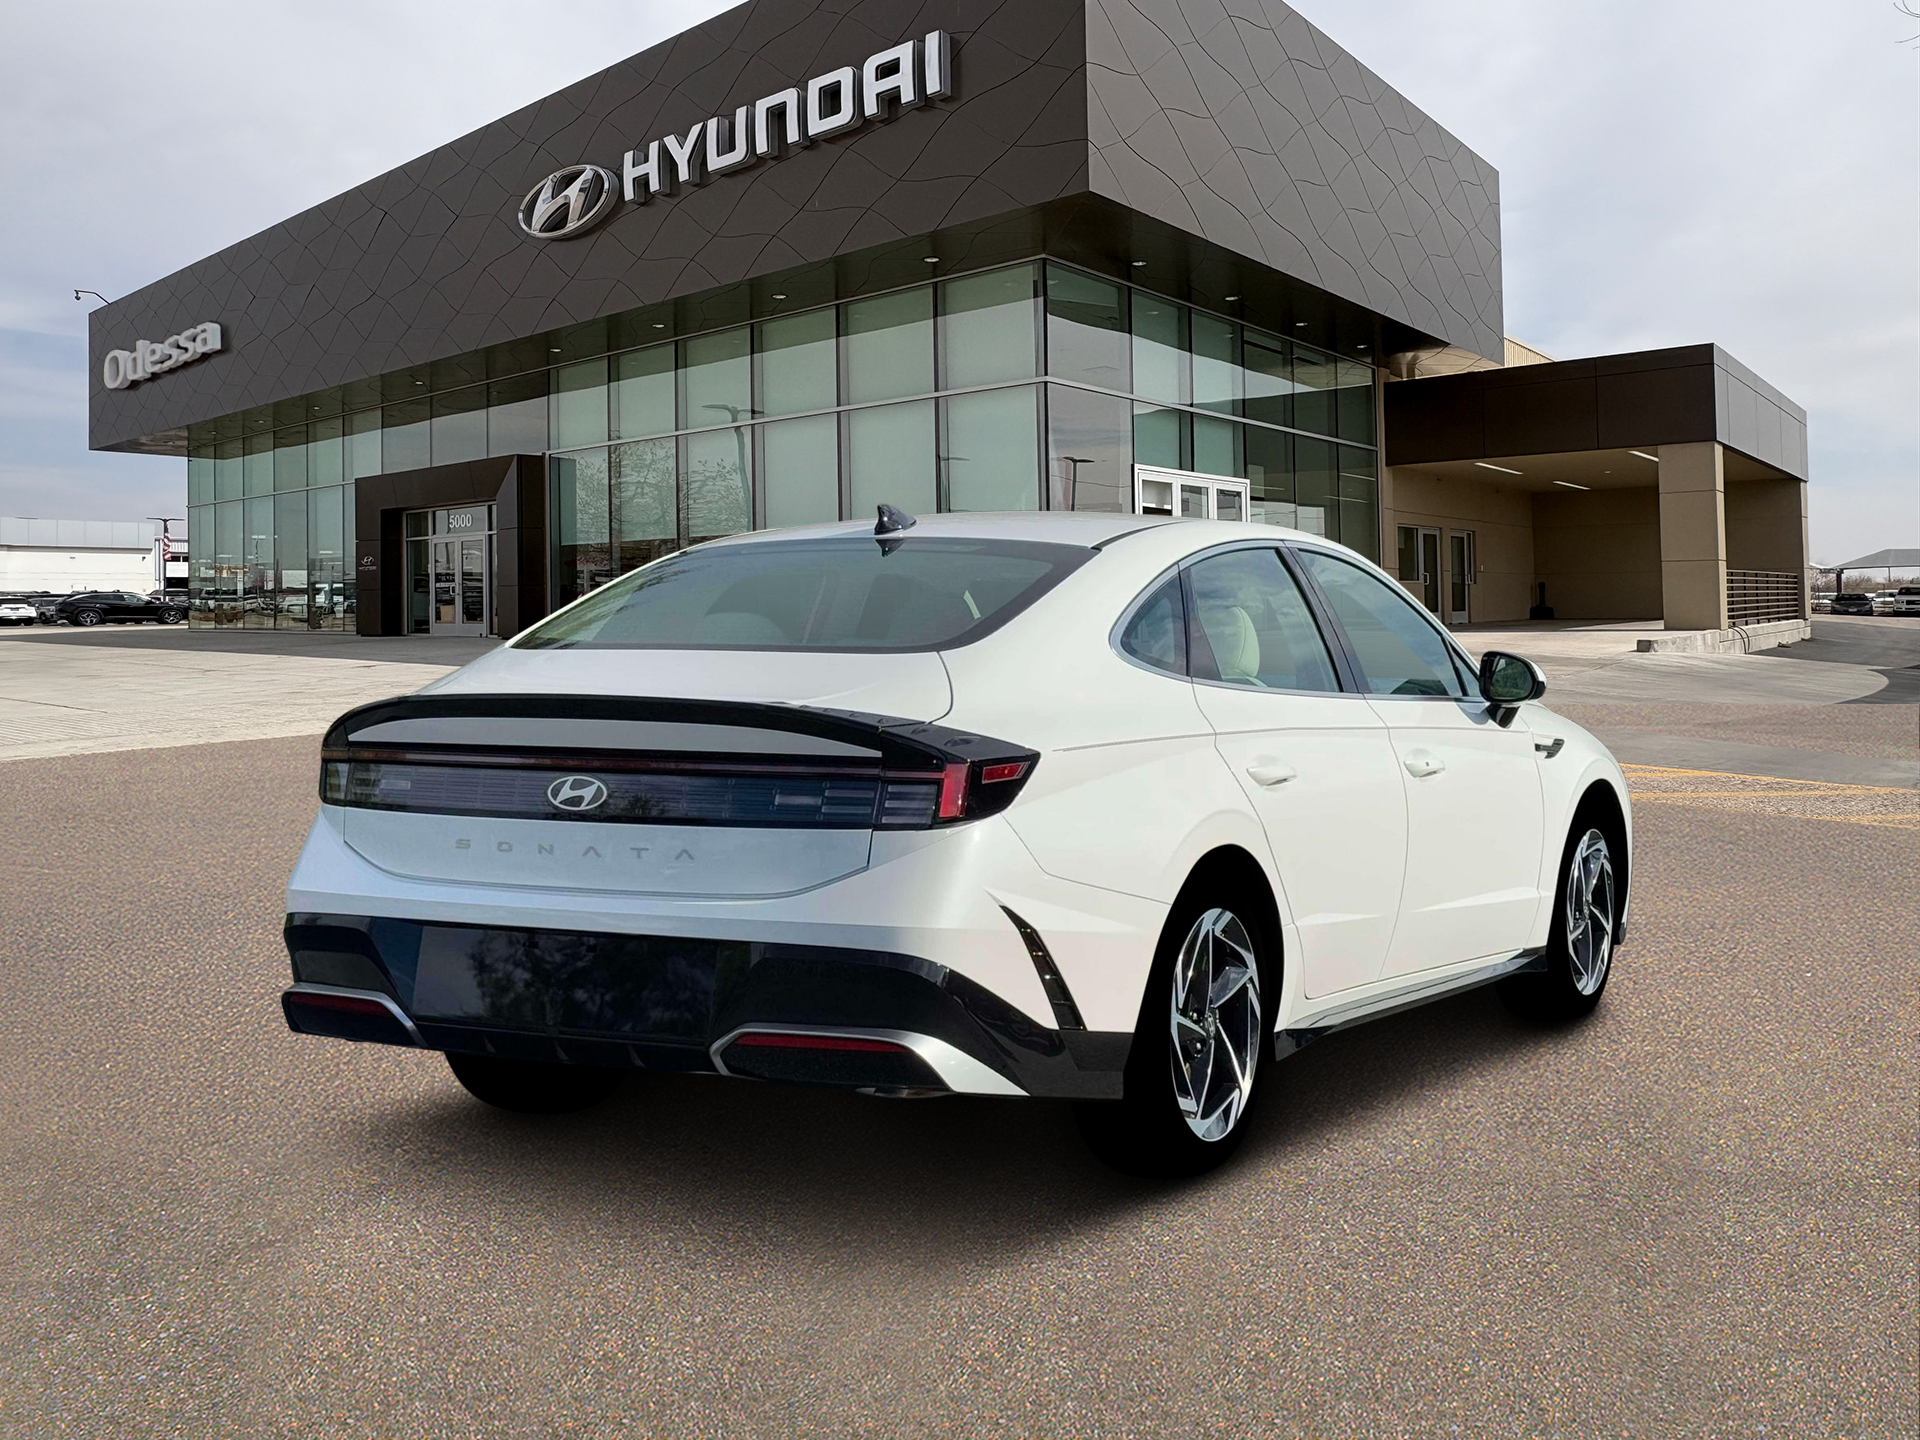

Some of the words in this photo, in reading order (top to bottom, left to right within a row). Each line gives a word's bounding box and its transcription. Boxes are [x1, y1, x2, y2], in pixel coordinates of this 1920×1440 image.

[622, 29, 951, 204] HYUNDAI
[103, 321, 222, 390] Odessa
[449, 513, 472, 529] 5000
[454, 838, 695, 861] SONATA
